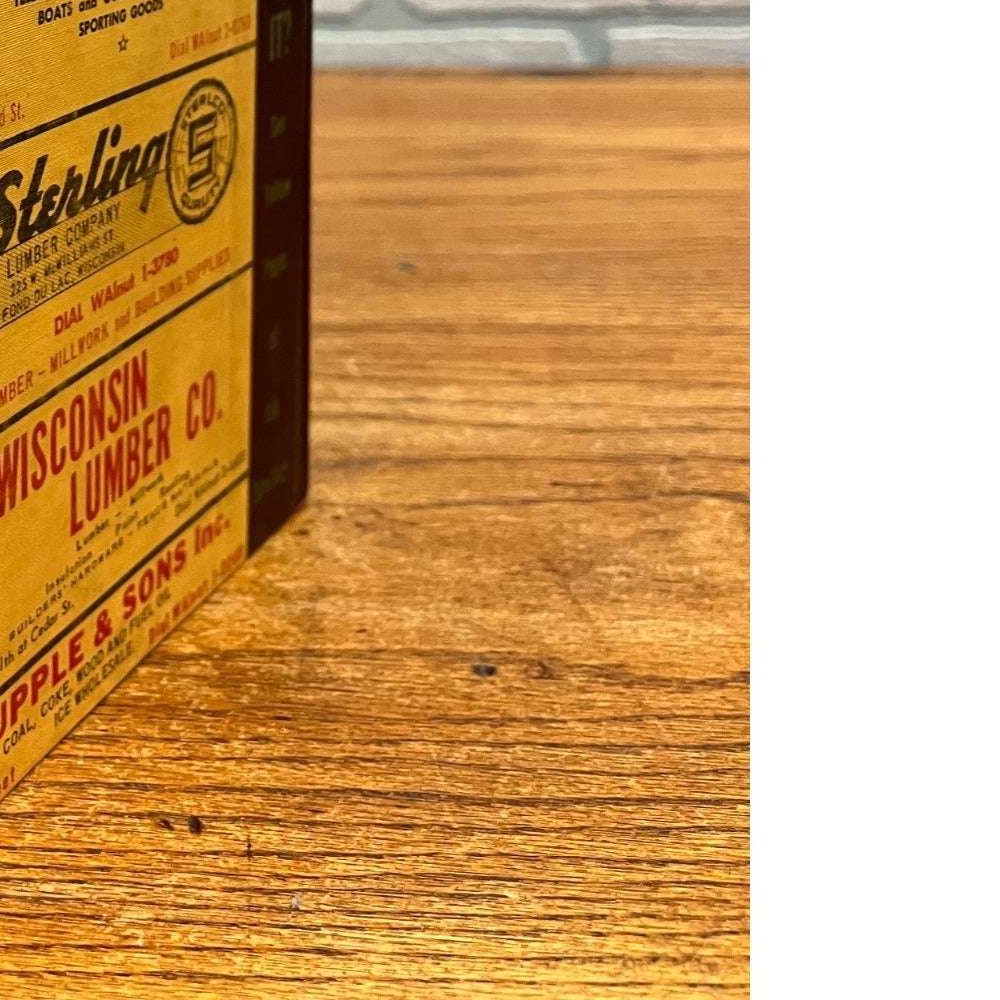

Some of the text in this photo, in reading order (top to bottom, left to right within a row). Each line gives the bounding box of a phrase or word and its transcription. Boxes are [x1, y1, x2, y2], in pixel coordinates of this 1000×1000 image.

[38, 1, 73, 25] BOATS
[78, 9, 126, 37] SPORTING
[10, 101, 26, 121] St.
[187, 111, 218, 192] S
[6, 202, 121, 279] LUMBER COMPANY
[2, 297, 30, 322] FOND
[34, 286, 48, 304] DU
[54, 303, 84, 336] DIAL
[90, 272, 136, 312] WAlnut
[50, 321, 110, 374] MILLWORK
[70, 405, 171, 537] LUMBER
[186, 368, 223, 440] CO.
[94, 608, 113, 647] &
[123, 539, 187, 620] SONS
[195, 513, 231, 555] Inc.
[18, 639, 29, 656] at
[31, 613, 59, 645] Cedar
[54, 702, 71, 728] ICE
